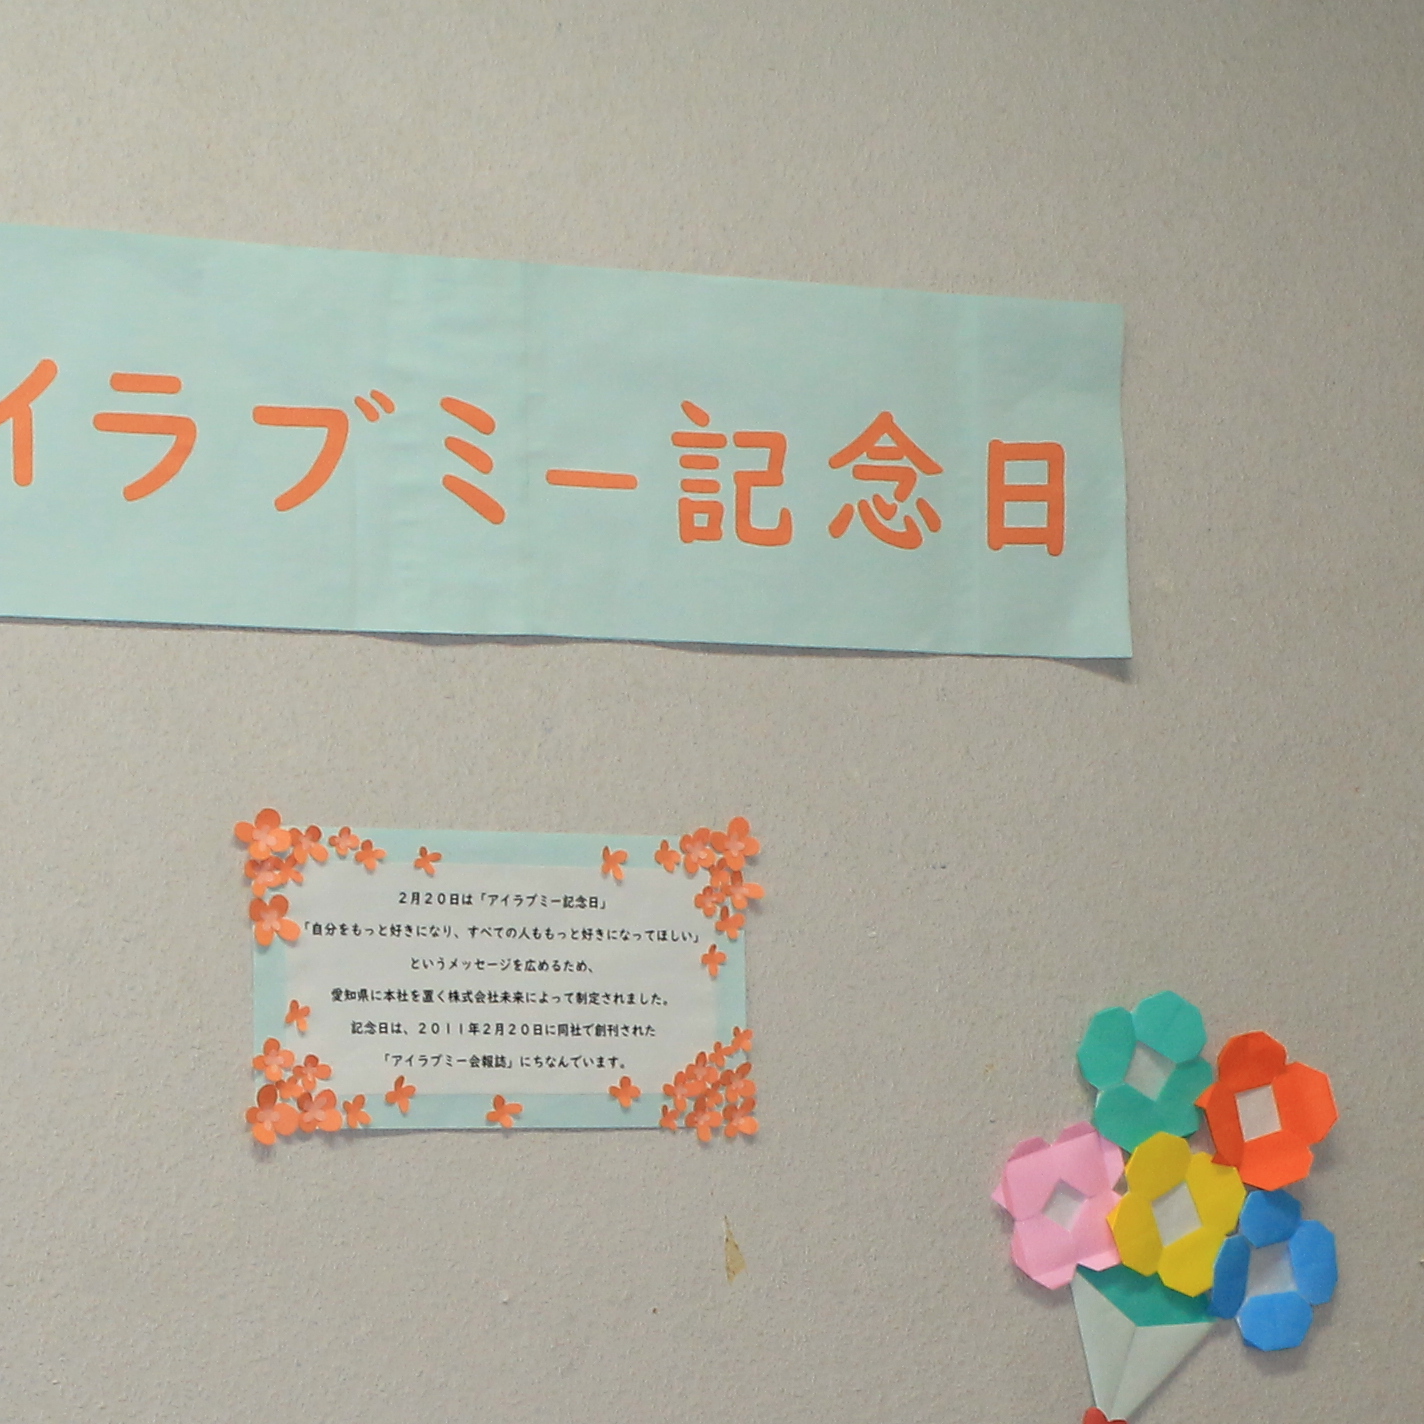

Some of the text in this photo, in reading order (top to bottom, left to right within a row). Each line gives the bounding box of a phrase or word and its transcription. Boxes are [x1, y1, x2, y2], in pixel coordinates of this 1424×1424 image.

[410, 956, 595, 974] というメッセージを広めるため、
[330, 987, 670, 1007] 愛知県に本社を置く株式会社未来によって制定されました。
[384, 1052, 627, 1071] 「アイラブミー会報誌」にちなんでいます。
